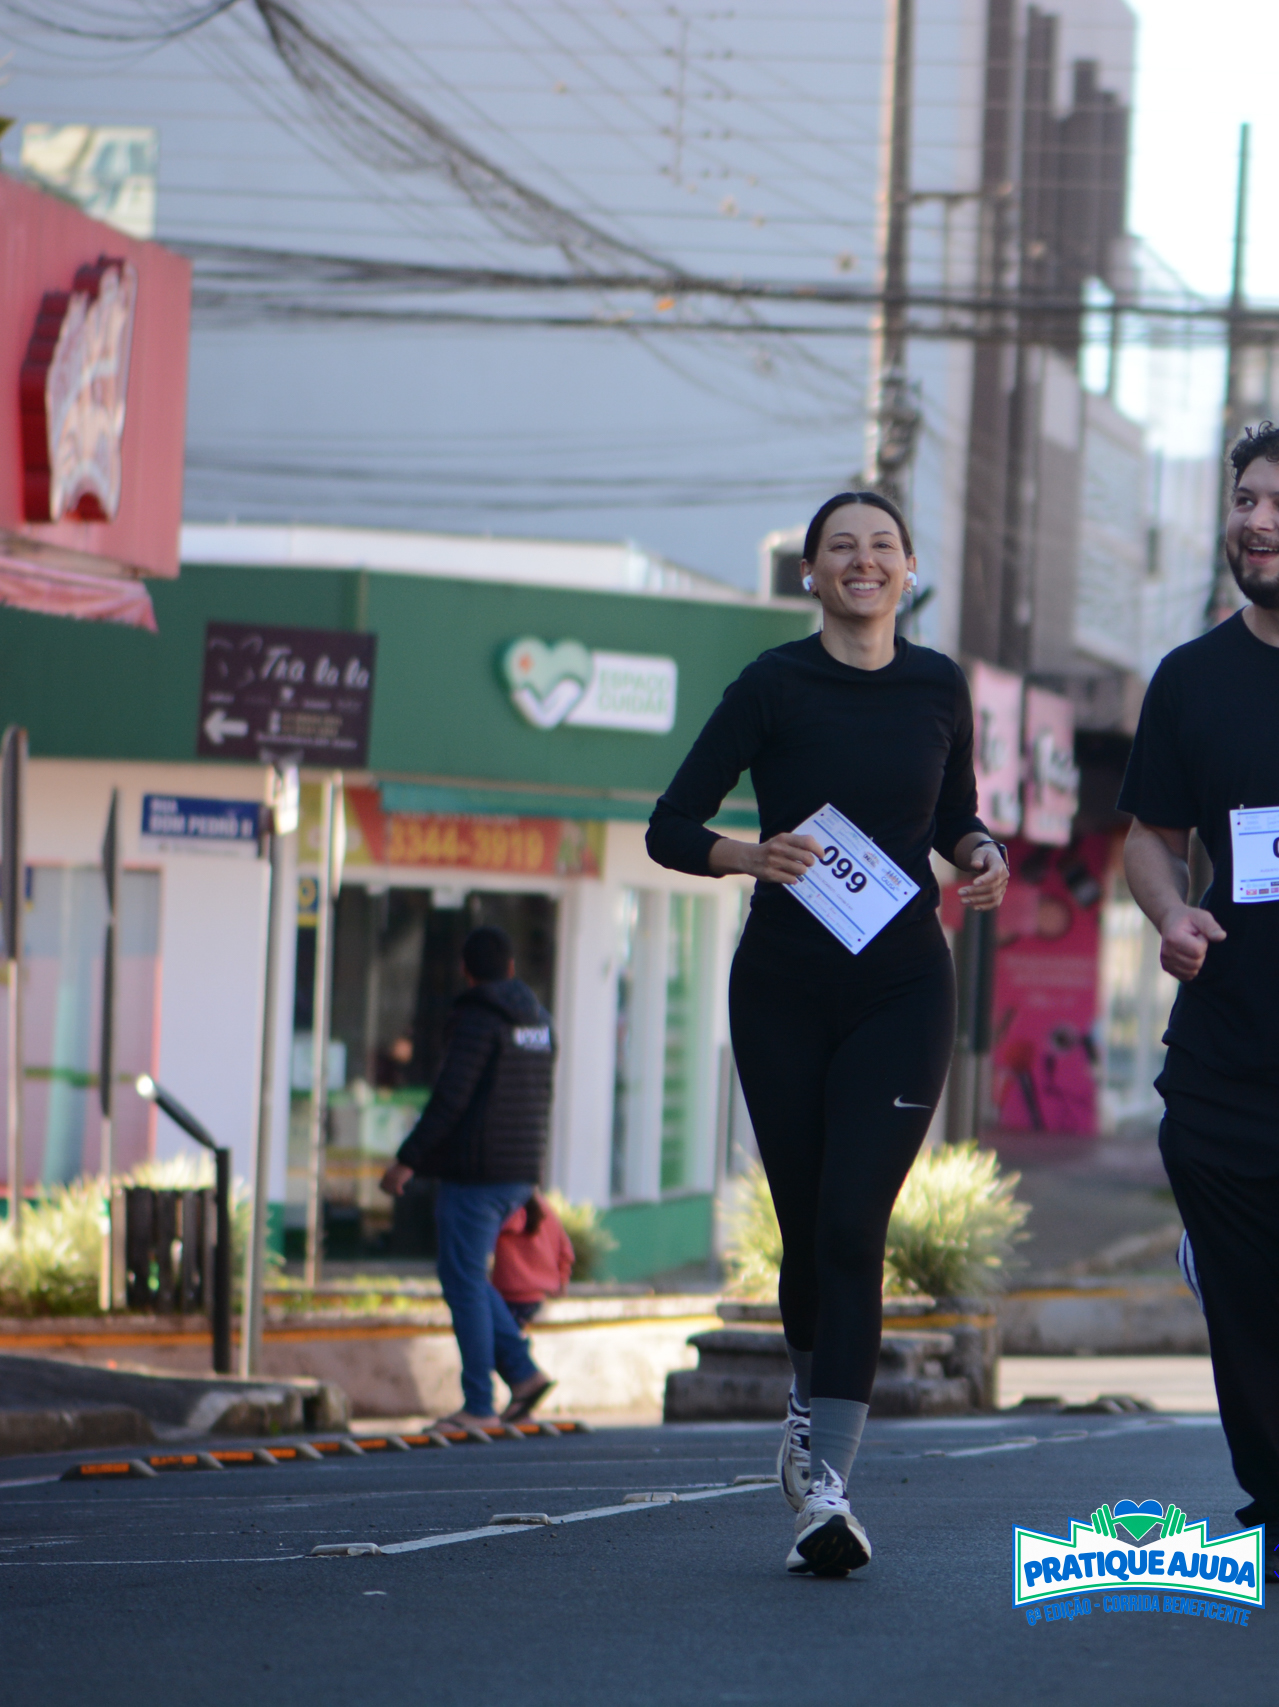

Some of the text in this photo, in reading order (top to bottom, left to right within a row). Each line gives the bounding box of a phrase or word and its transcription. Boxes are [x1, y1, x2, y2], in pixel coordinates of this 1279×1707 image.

[314, 654, 340, 687] la
[344, 657, 370, 688] la
[819, 846, 867, 893] 099
